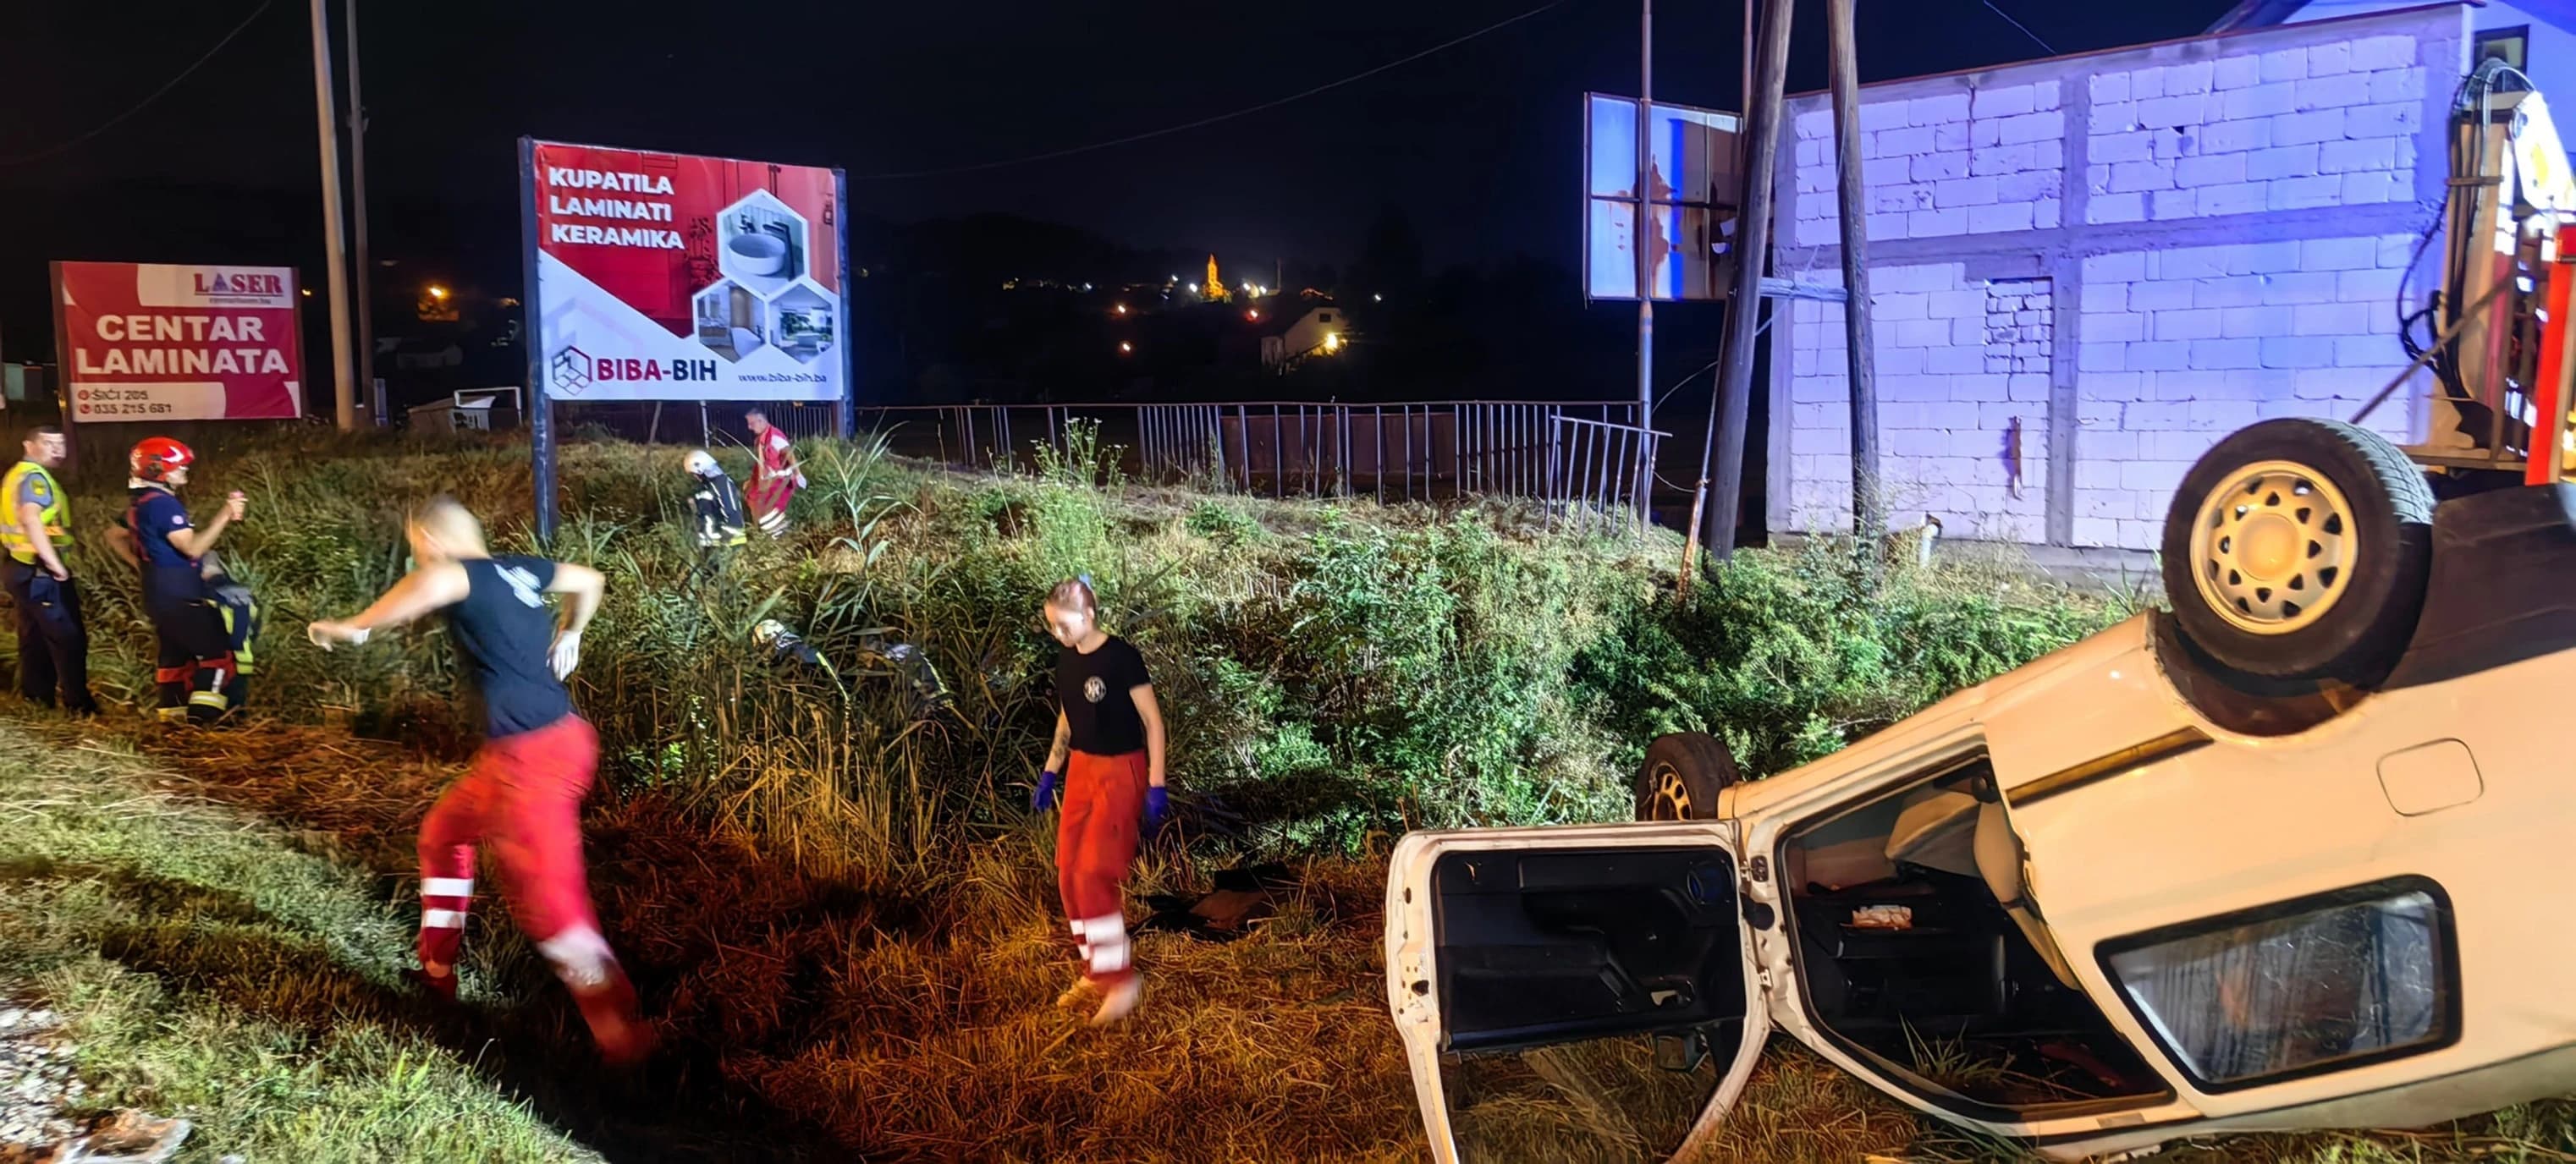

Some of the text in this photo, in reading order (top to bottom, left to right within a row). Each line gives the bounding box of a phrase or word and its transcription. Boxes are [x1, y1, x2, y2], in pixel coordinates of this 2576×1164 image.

[548, 167, 675, 195] KUPATILA
[550, 195, 673, 222] LAMINATI
[551, 222, 685, 250] KERAMIKA
[194, 272, 284, 294] LASER
[96, 315, 266, 342] CENTAR
[75, 348, 289, 375] LAMINATA
[597, 358, 718, 382] BIBA-BIH
